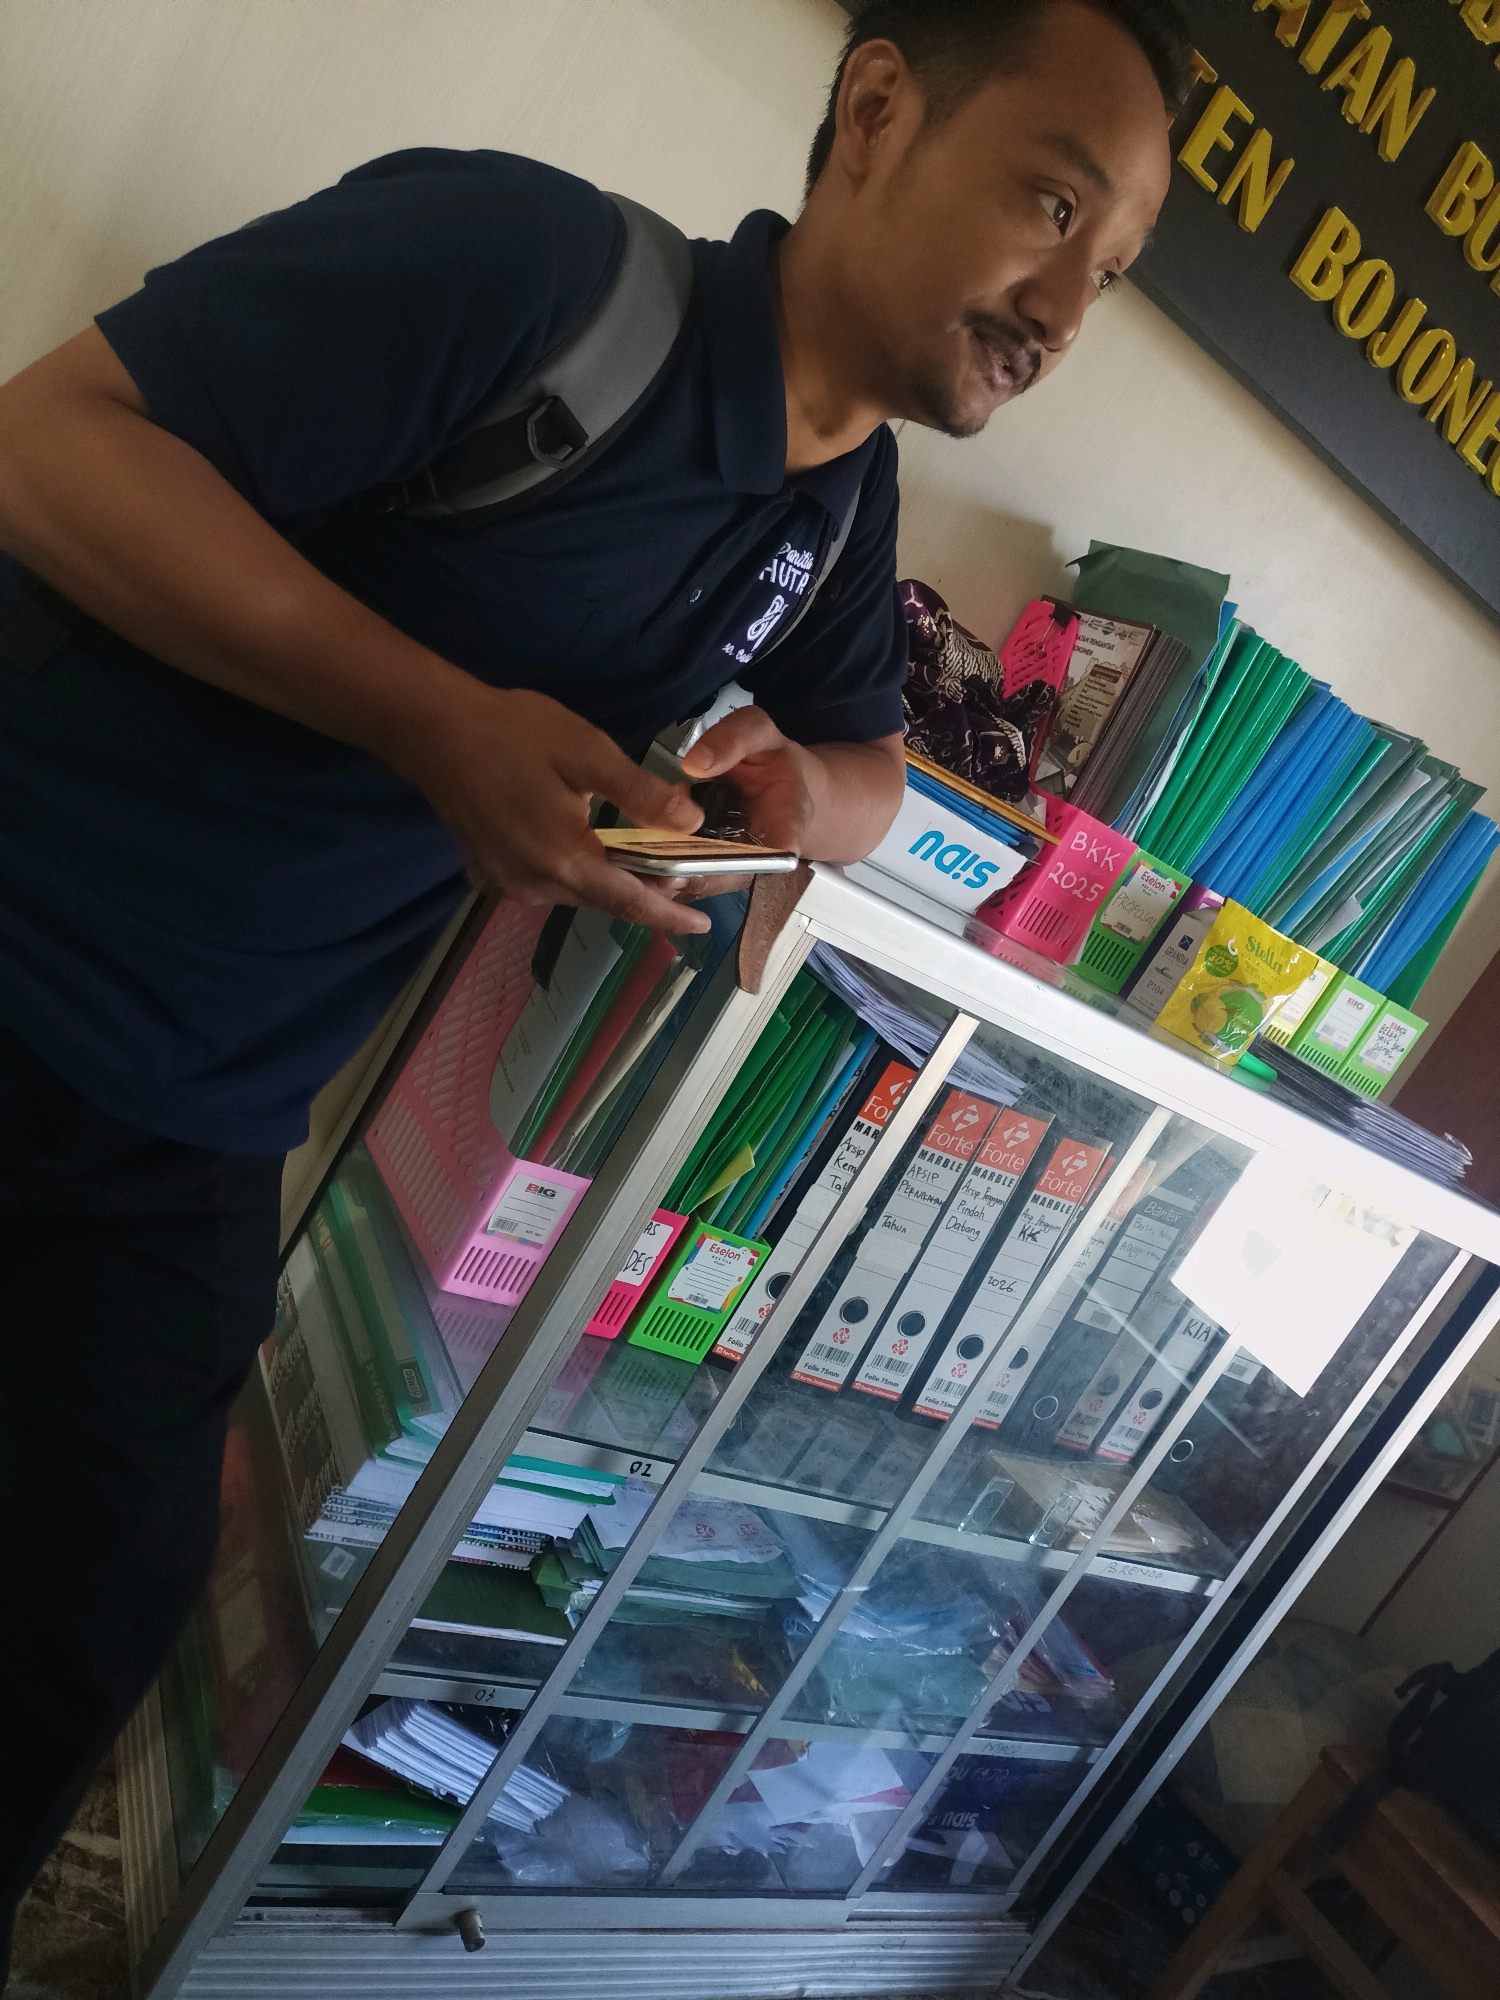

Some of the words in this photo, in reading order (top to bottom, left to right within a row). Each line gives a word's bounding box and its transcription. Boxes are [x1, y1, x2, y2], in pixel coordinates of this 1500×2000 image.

[1069, 830, 1121, 873] BKK
[1049, 861, 1105, 903] 2025
[1140, 870, 1167, 893] Eselon
[1112, 890, 1159, 931] PROPOSAL
[1163, 946, 1191, 968] GRANDIA
[1208, 953, 1234, 972] 30%
[1244, 935, 1284, 976] Stella
[1145, 979, 1166, 996] P104
[1347, 996, 1365, 1011] BIG
[1390, 1021, 1407, 1036] BIG
[926, 1123, 975, 1157] Forte
[917, 1148, 964, 1175] MARBLE
[980, 1141, 1026, 1172] Forte
[970, 1165, 1016, 1189] MARBLE
[1039, 1168, 1084, 1199] Forte
[526, 1182, 557, 1199] BIG
[956, 1200, 986, 1220] Pindah
[1030, 1193, 1073, 1216] MARBLE
[1142, 1200, 1181, 1225] Bantex
[882, 1213, 907, 1235] Tahun
[945, 1214, 982, 1243] Datang
[708, 1242, 742, 1263] Eselon
[1182, 1317, 1212, 1343] KIA
[726, 1336, 744, 1349] Folio
[803, 1361, 821, 1372] Folio
[820, 1366, 840, 1379] 75mm
[864, 1371, 881, 1383] Folio
[880, 1376, 900, 1388] 75mm
[924, 1396, 940, 1406] Folio
[1107, 1440, 1121, 1449] Folio
